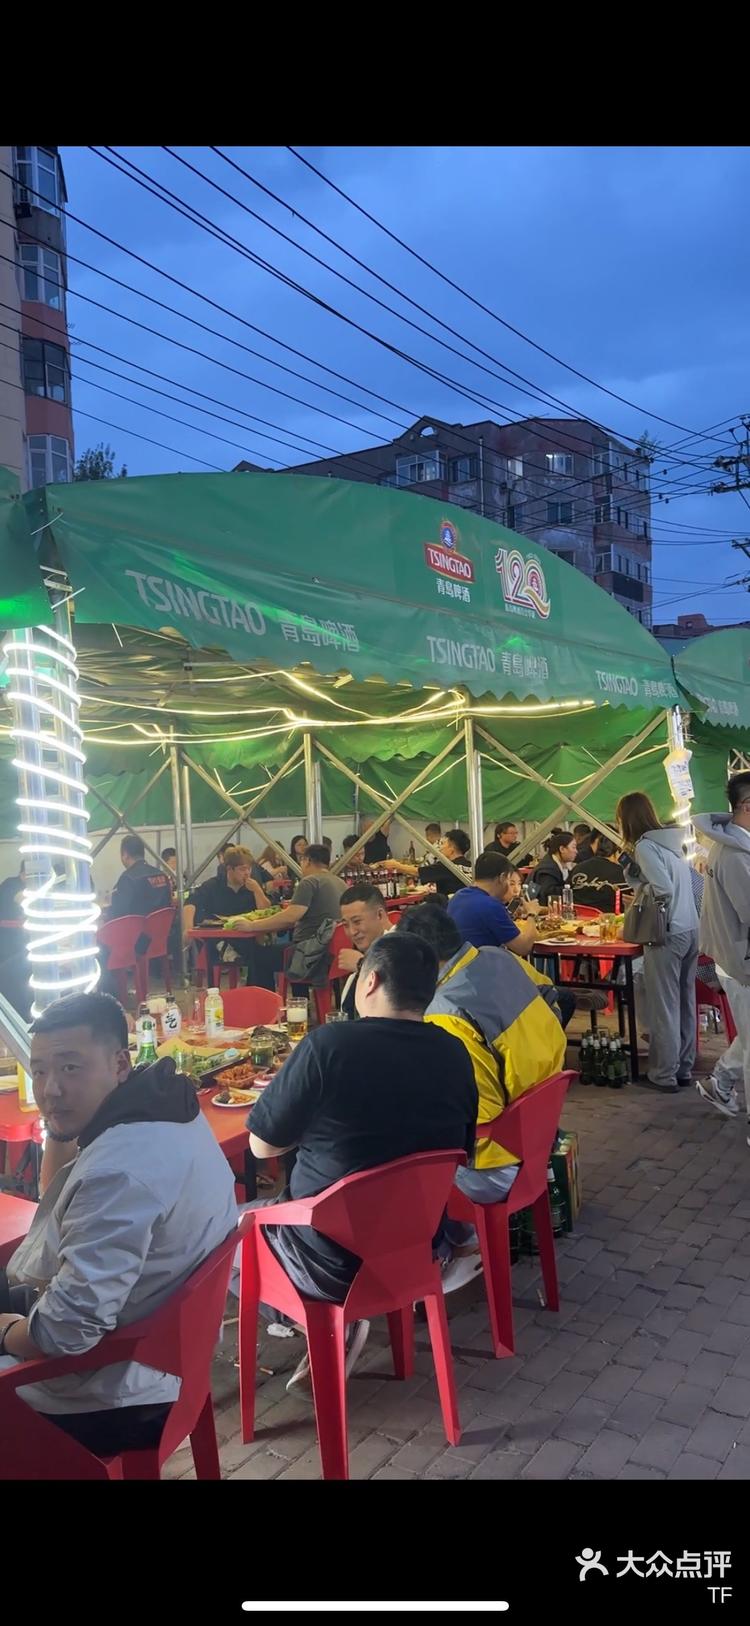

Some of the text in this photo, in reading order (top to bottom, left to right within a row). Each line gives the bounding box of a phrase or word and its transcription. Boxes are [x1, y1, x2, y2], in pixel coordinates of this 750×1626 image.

[427, 548, 471, 578] TSINGTAO
[436, 578, 471, 603] 青岛啤酒
[125, 570, 360, 653] TSINGTAO 青岛啤酒
[426, 636, 549, 681] TSINGTAO 青岛啤酒
[595, 670, 638, 697] TSINGTAO
